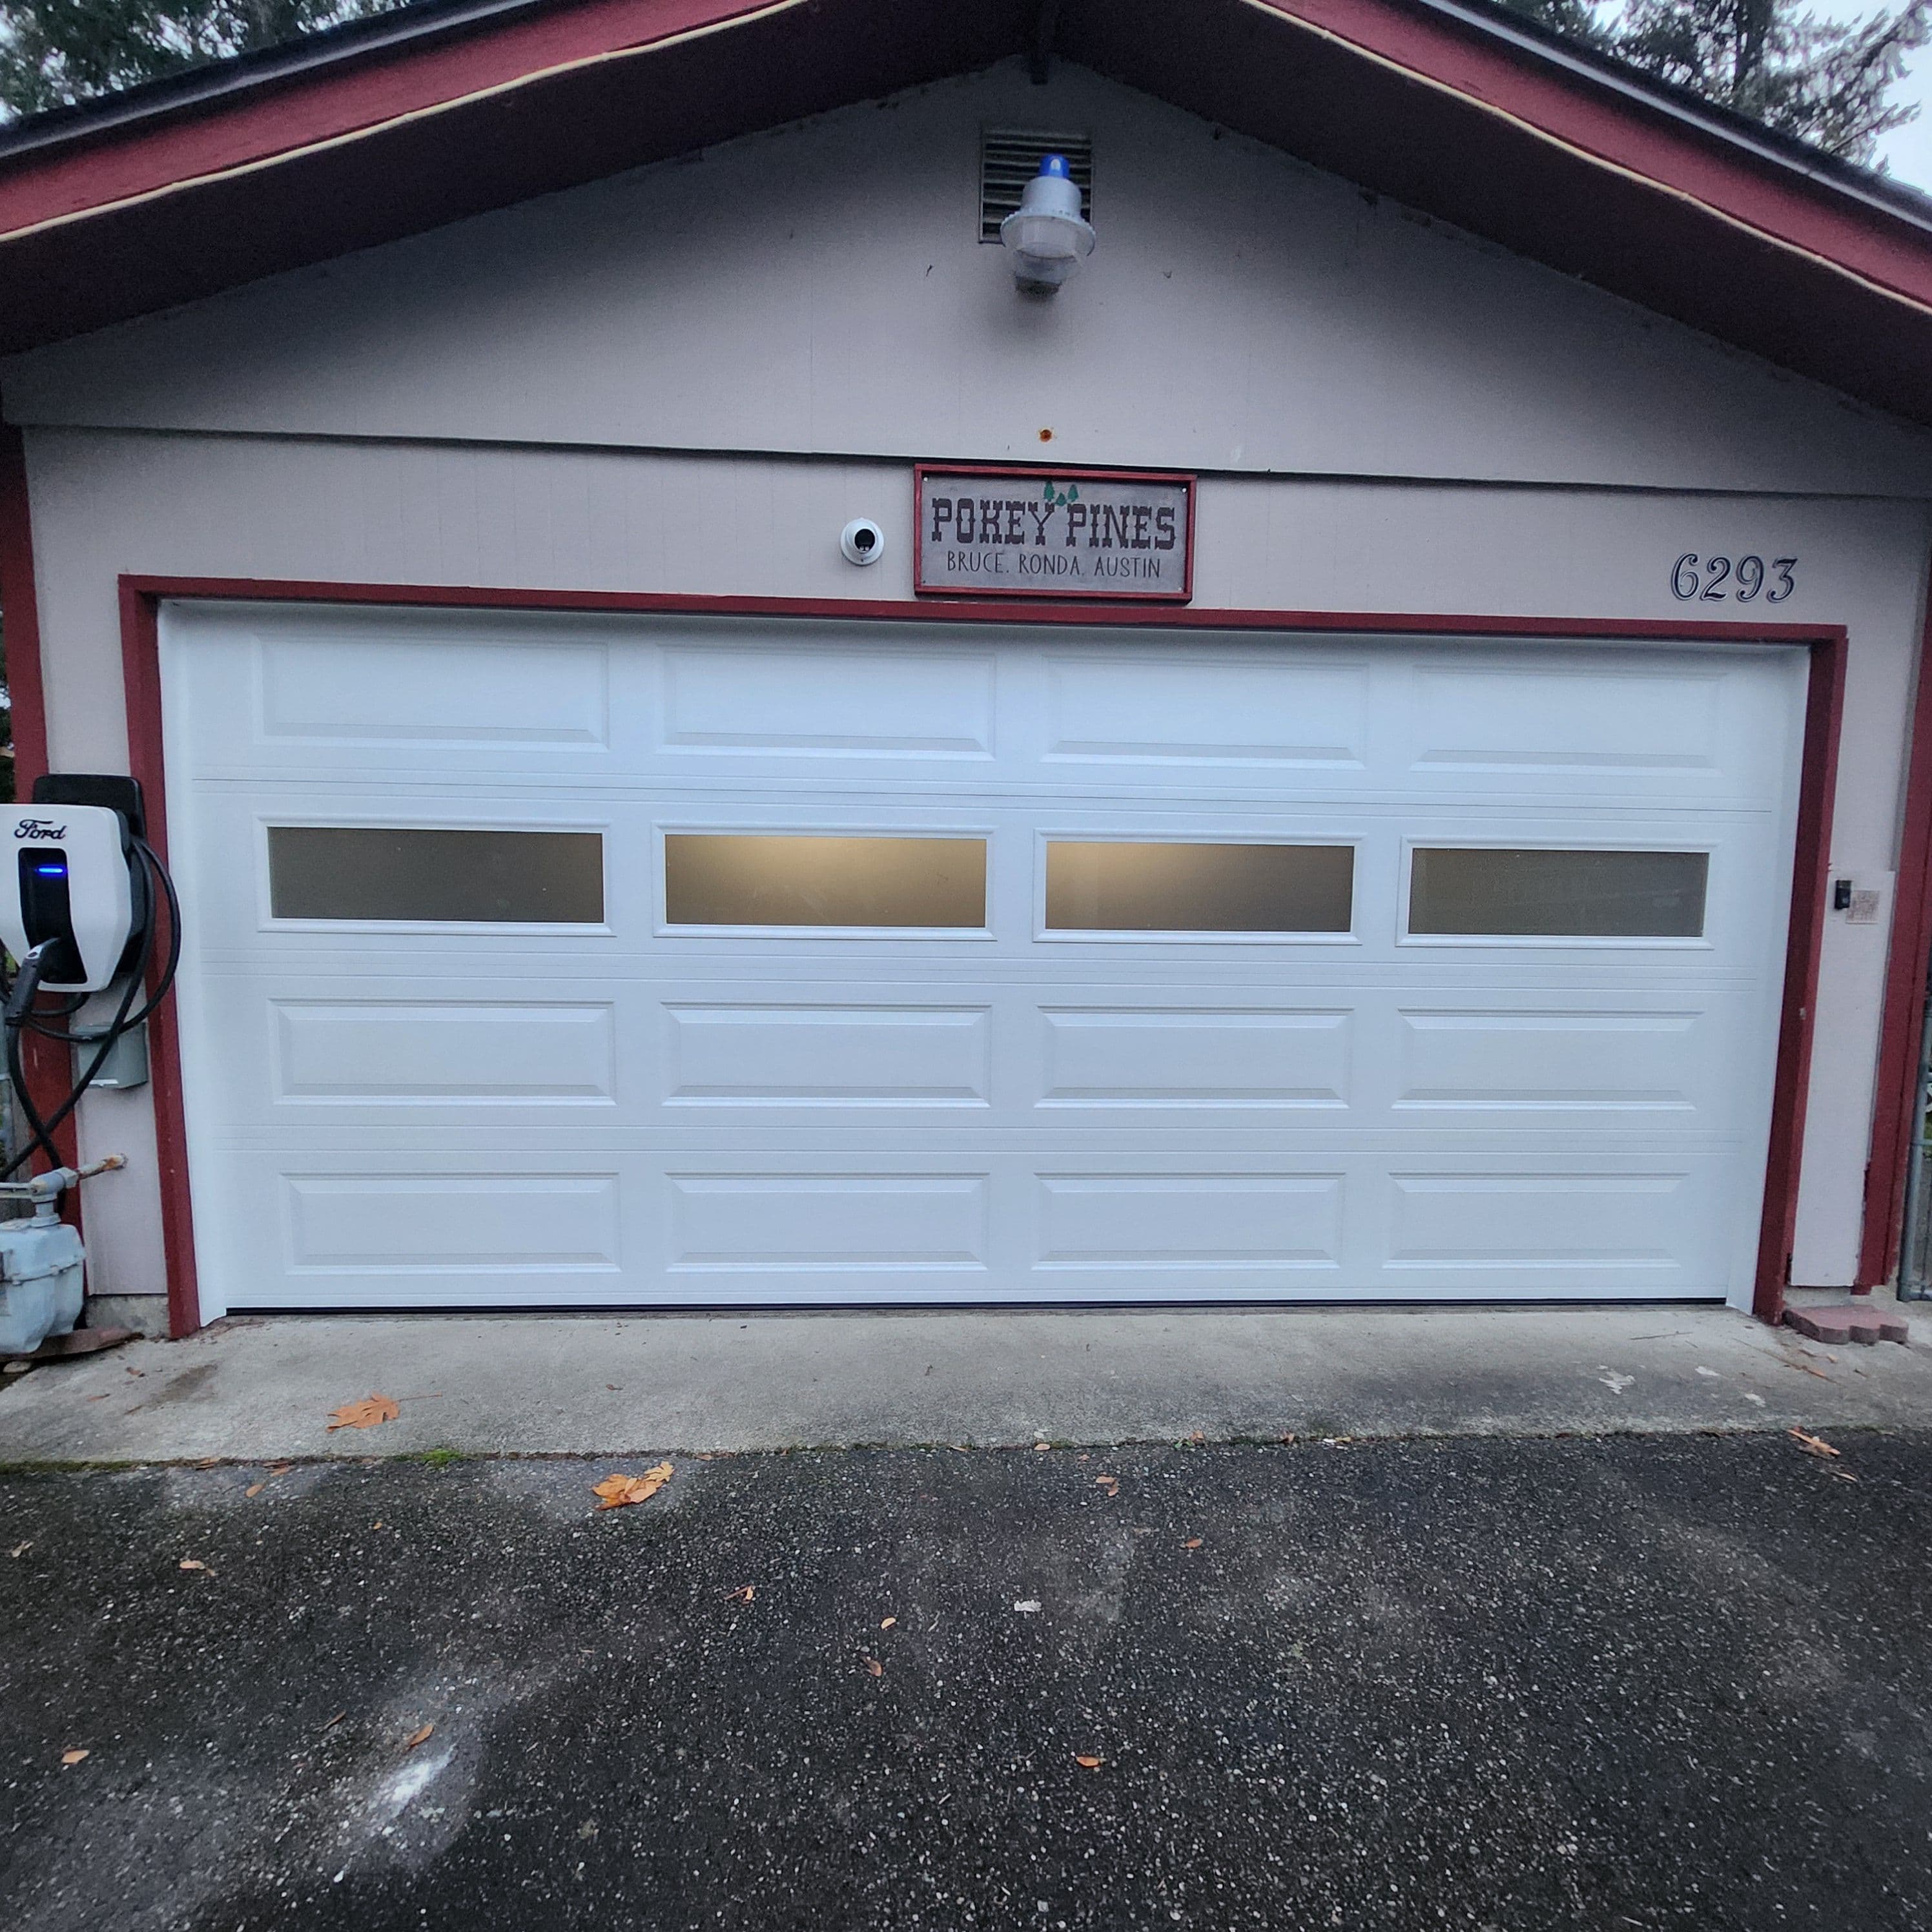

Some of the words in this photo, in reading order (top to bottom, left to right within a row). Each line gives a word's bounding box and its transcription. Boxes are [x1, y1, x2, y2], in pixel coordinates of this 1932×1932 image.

[931, 497, 1055, 546] POKEY
[1065, 503, 1176, 550] PINES
[1094, 556, 1160, 578] AUSTIN
[1670, 553, 1798, 604] 6293
[14, 819, 67, 839] Ford
